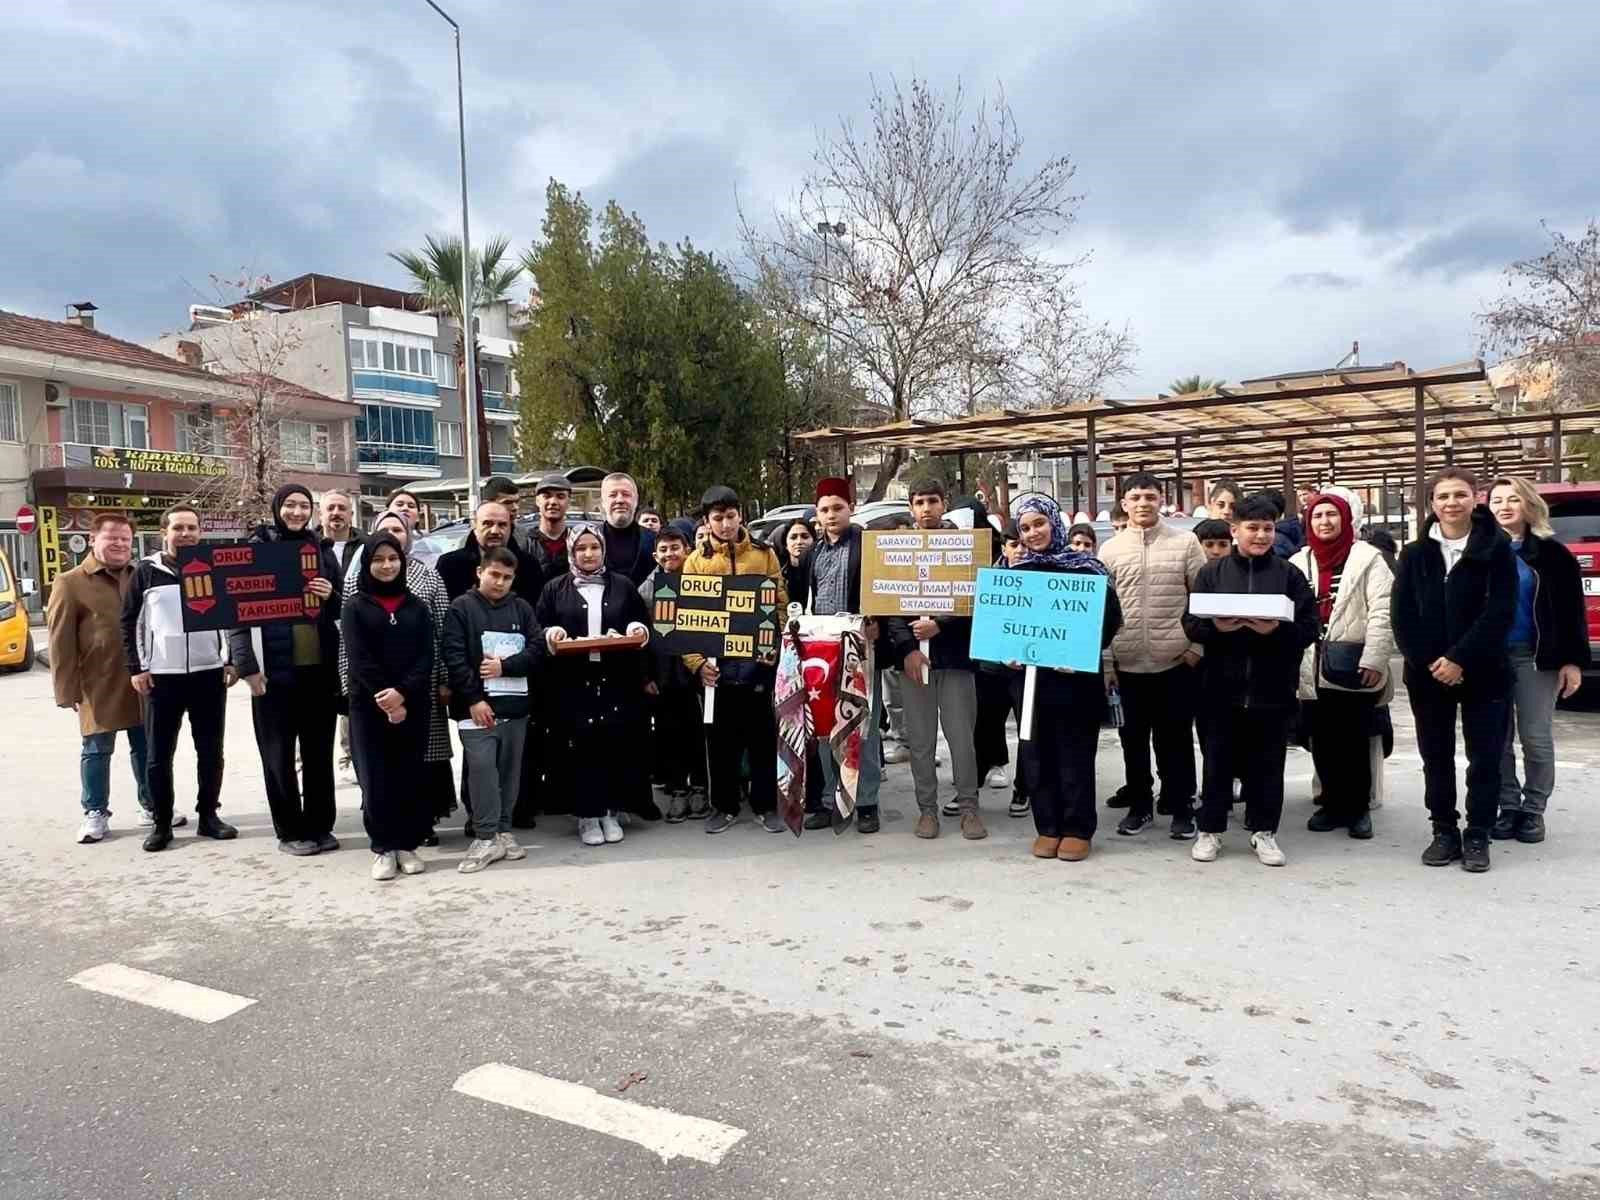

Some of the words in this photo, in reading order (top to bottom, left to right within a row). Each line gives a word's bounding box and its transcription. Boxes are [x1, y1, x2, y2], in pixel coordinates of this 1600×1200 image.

[681, 580, 722, 596] ORUÇ
[992, 575, 1023, 591] HOŞ
[1047, 577, 1096, 593] ONBİR
[727, 595, 754, 609] TUT
[979, 592, 1033, 608] GELDİN
[1050, 599, 1089, 614] AYIN
[677, 613, 729, 629] SIHHAT
[1002, 622, 1068, 641] SULTANI
[725, 640, 753, 654] BUL
